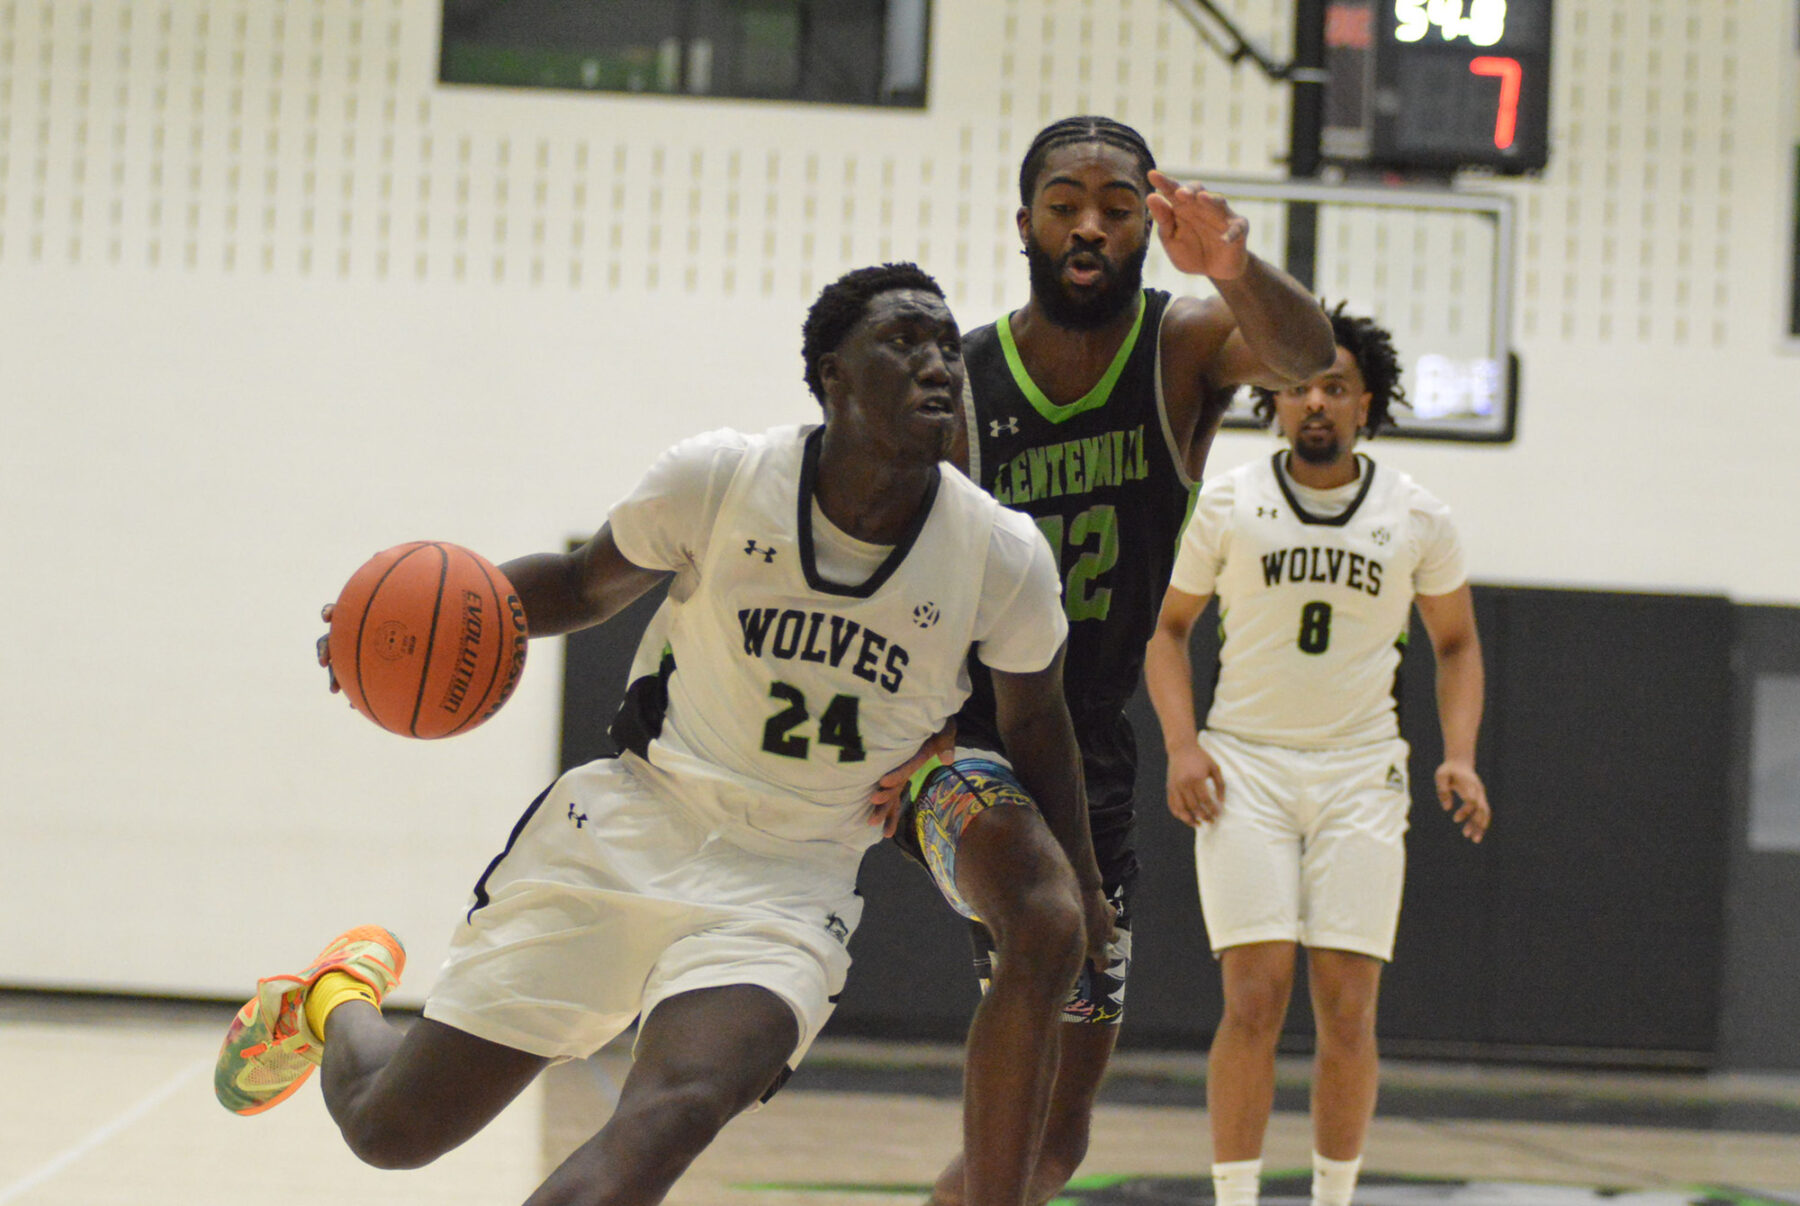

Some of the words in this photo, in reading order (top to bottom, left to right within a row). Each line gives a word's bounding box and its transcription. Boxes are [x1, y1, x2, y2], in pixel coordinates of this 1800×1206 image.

[1469, 56, 1522, 149] 7
[1261, 546, 1383, 597] WOLVES
[443, 590, 484, 714] EVOLUTION
[738, 608, 909, 694] WOLVES
[1298, 601, 1332, 655] 8
[761, 681, 866, 763] 24
